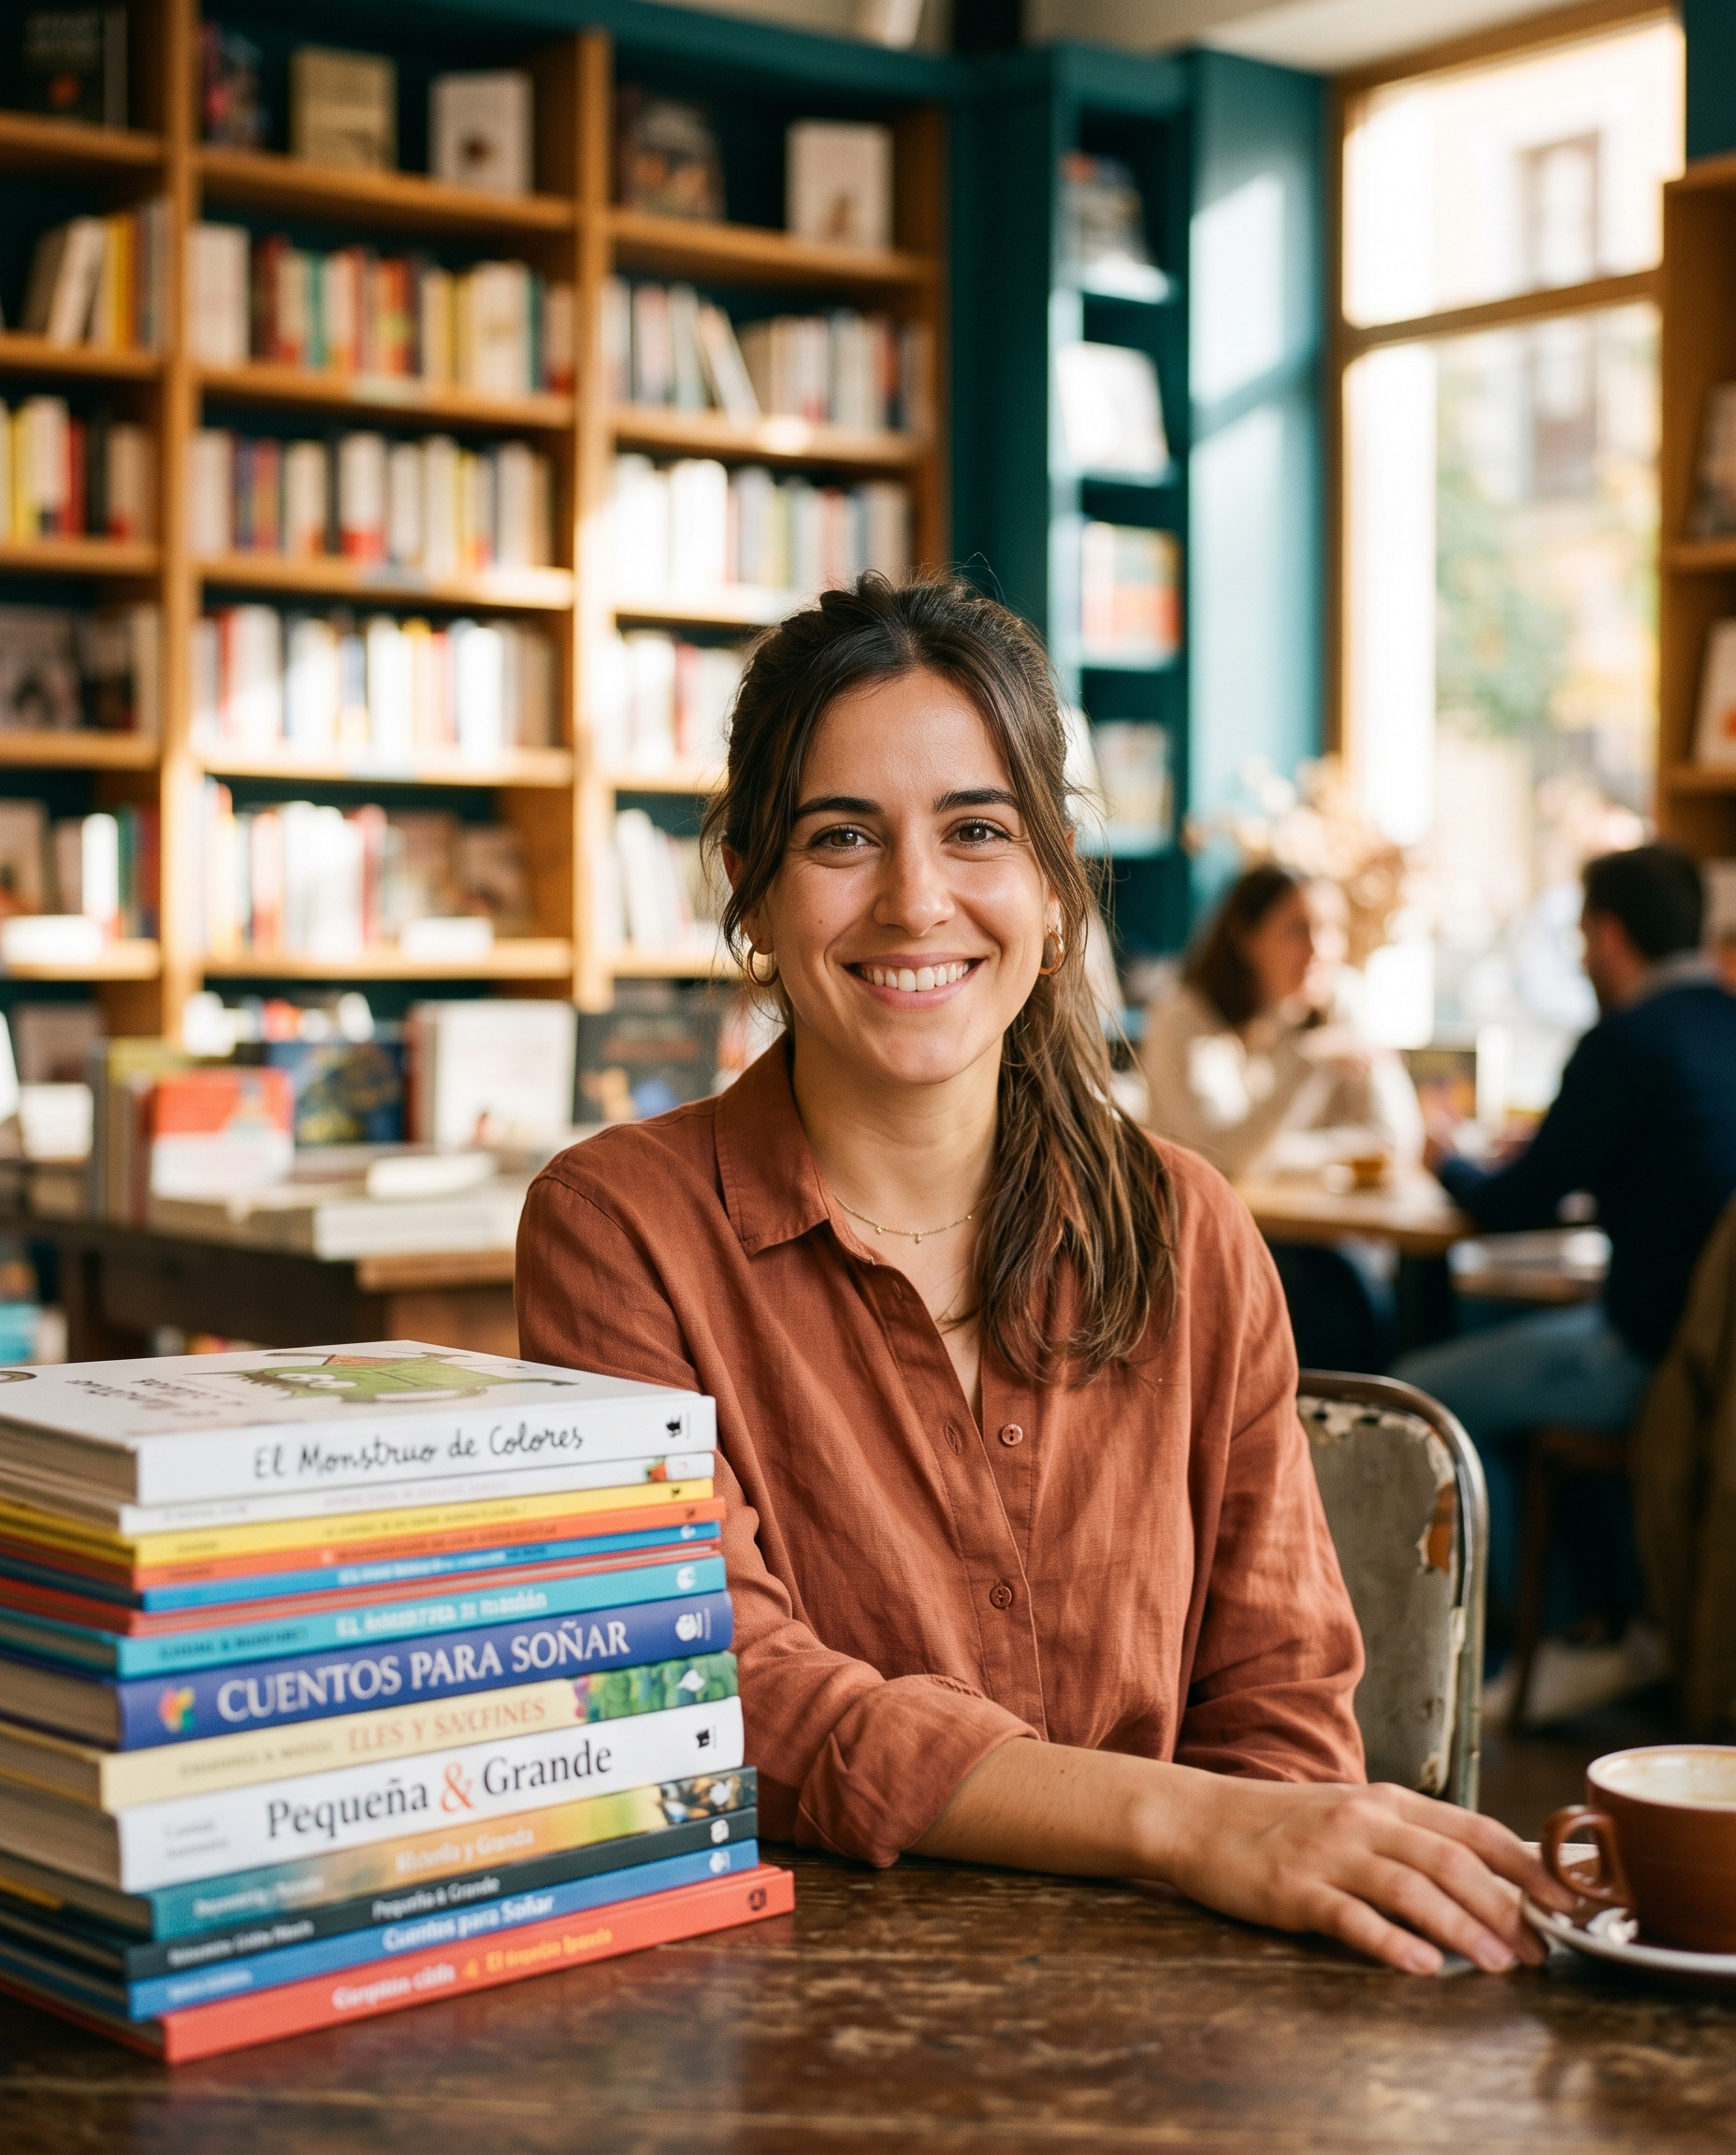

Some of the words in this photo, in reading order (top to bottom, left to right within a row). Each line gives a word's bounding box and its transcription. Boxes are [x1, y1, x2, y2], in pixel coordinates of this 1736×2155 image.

[254, 1444, 283, 1479] El
[297, 1439, 438, 1474] Monstruo
[448, 1427, 481, 1457] de
[489, 1422, 584, 1456] Colores
[216, 1656, 402, 1723] CUENTOS
[410, 1641, 502, 1689] PARA
[511, 1619, 631, 1673] SOÑAR
[266, 1778, 429, 1841] Pequeña
[440, 1760, 475, 1814] &
[483, 1740, 613, 1796] Grande
[447, 1876, 501, 1902] Grande
[382, 1917, 456, 1952] Cuentos
[457, 1908, 500, 1938] para
[500, 1895, 556, 1923] Soñar
